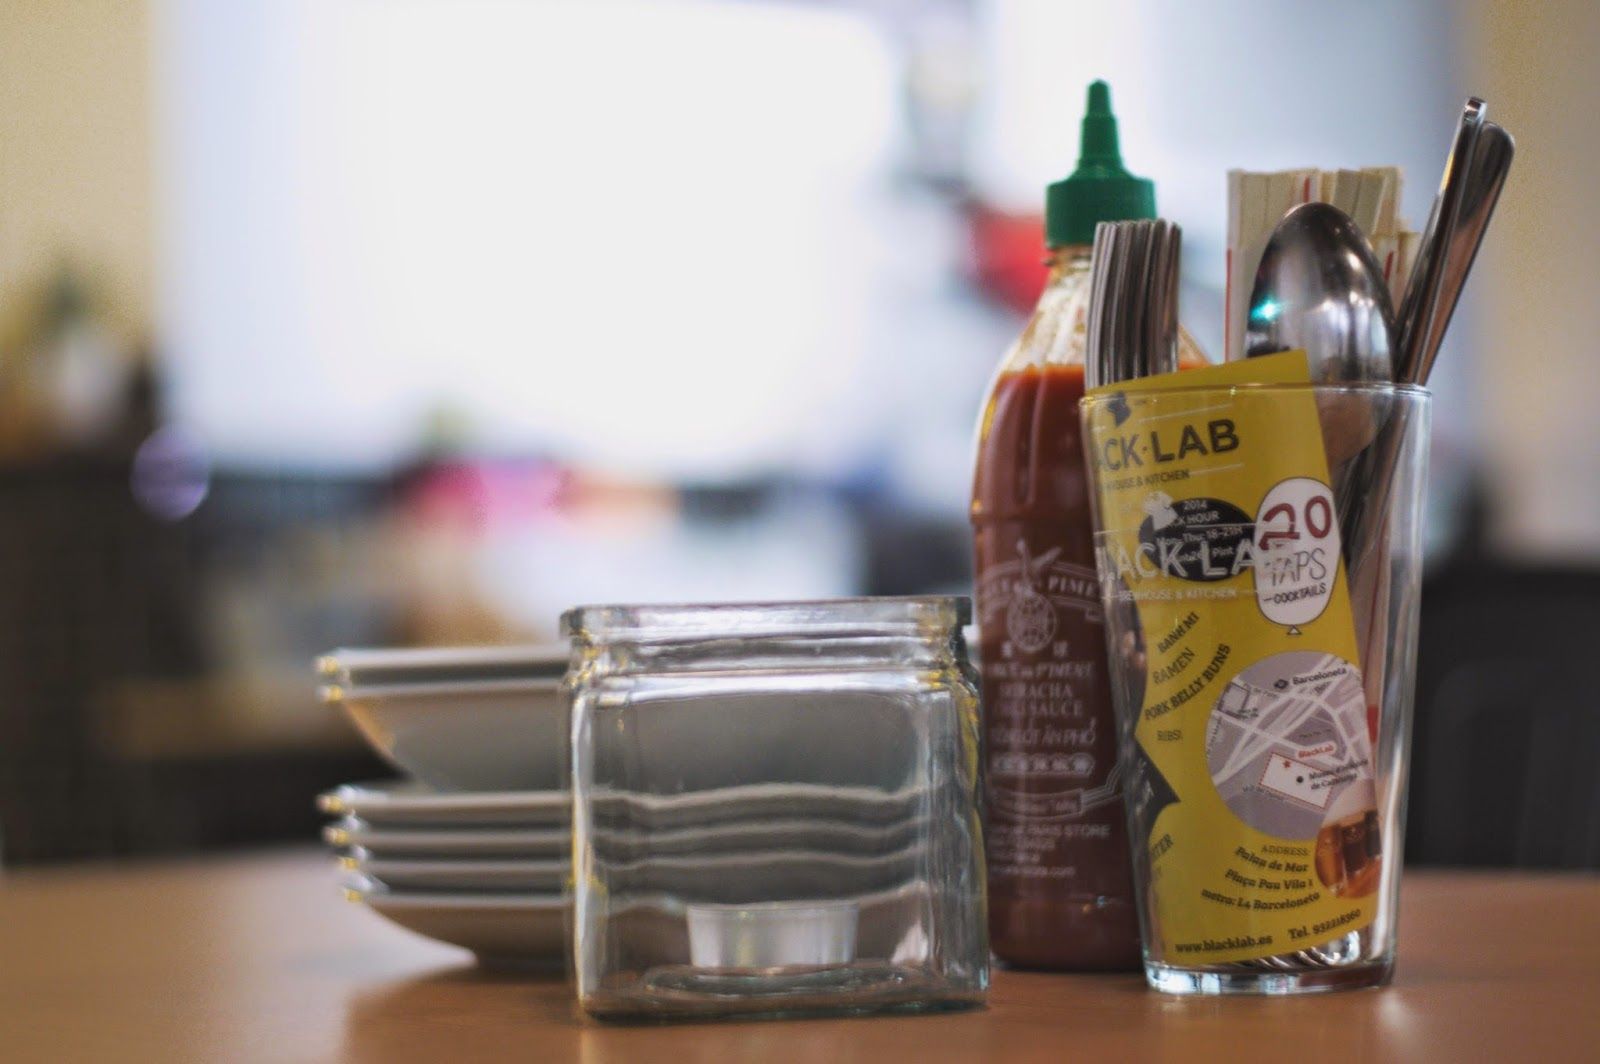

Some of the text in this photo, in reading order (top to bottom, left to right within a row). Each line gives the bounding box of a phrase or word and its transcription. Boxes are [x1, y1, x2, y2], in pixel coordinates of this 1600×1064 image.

[1187, 509, 1220, 524] HOUR
[1258, 495, 1331, 550] 20
[1152, 646, 1196, 684] RAMEN
[1144, 643, 1231, 721] PORK BELLY BUNS
[1268, 859, 1283, 870] de
[1175, 934, 1273, 953] www.blacklab.es
